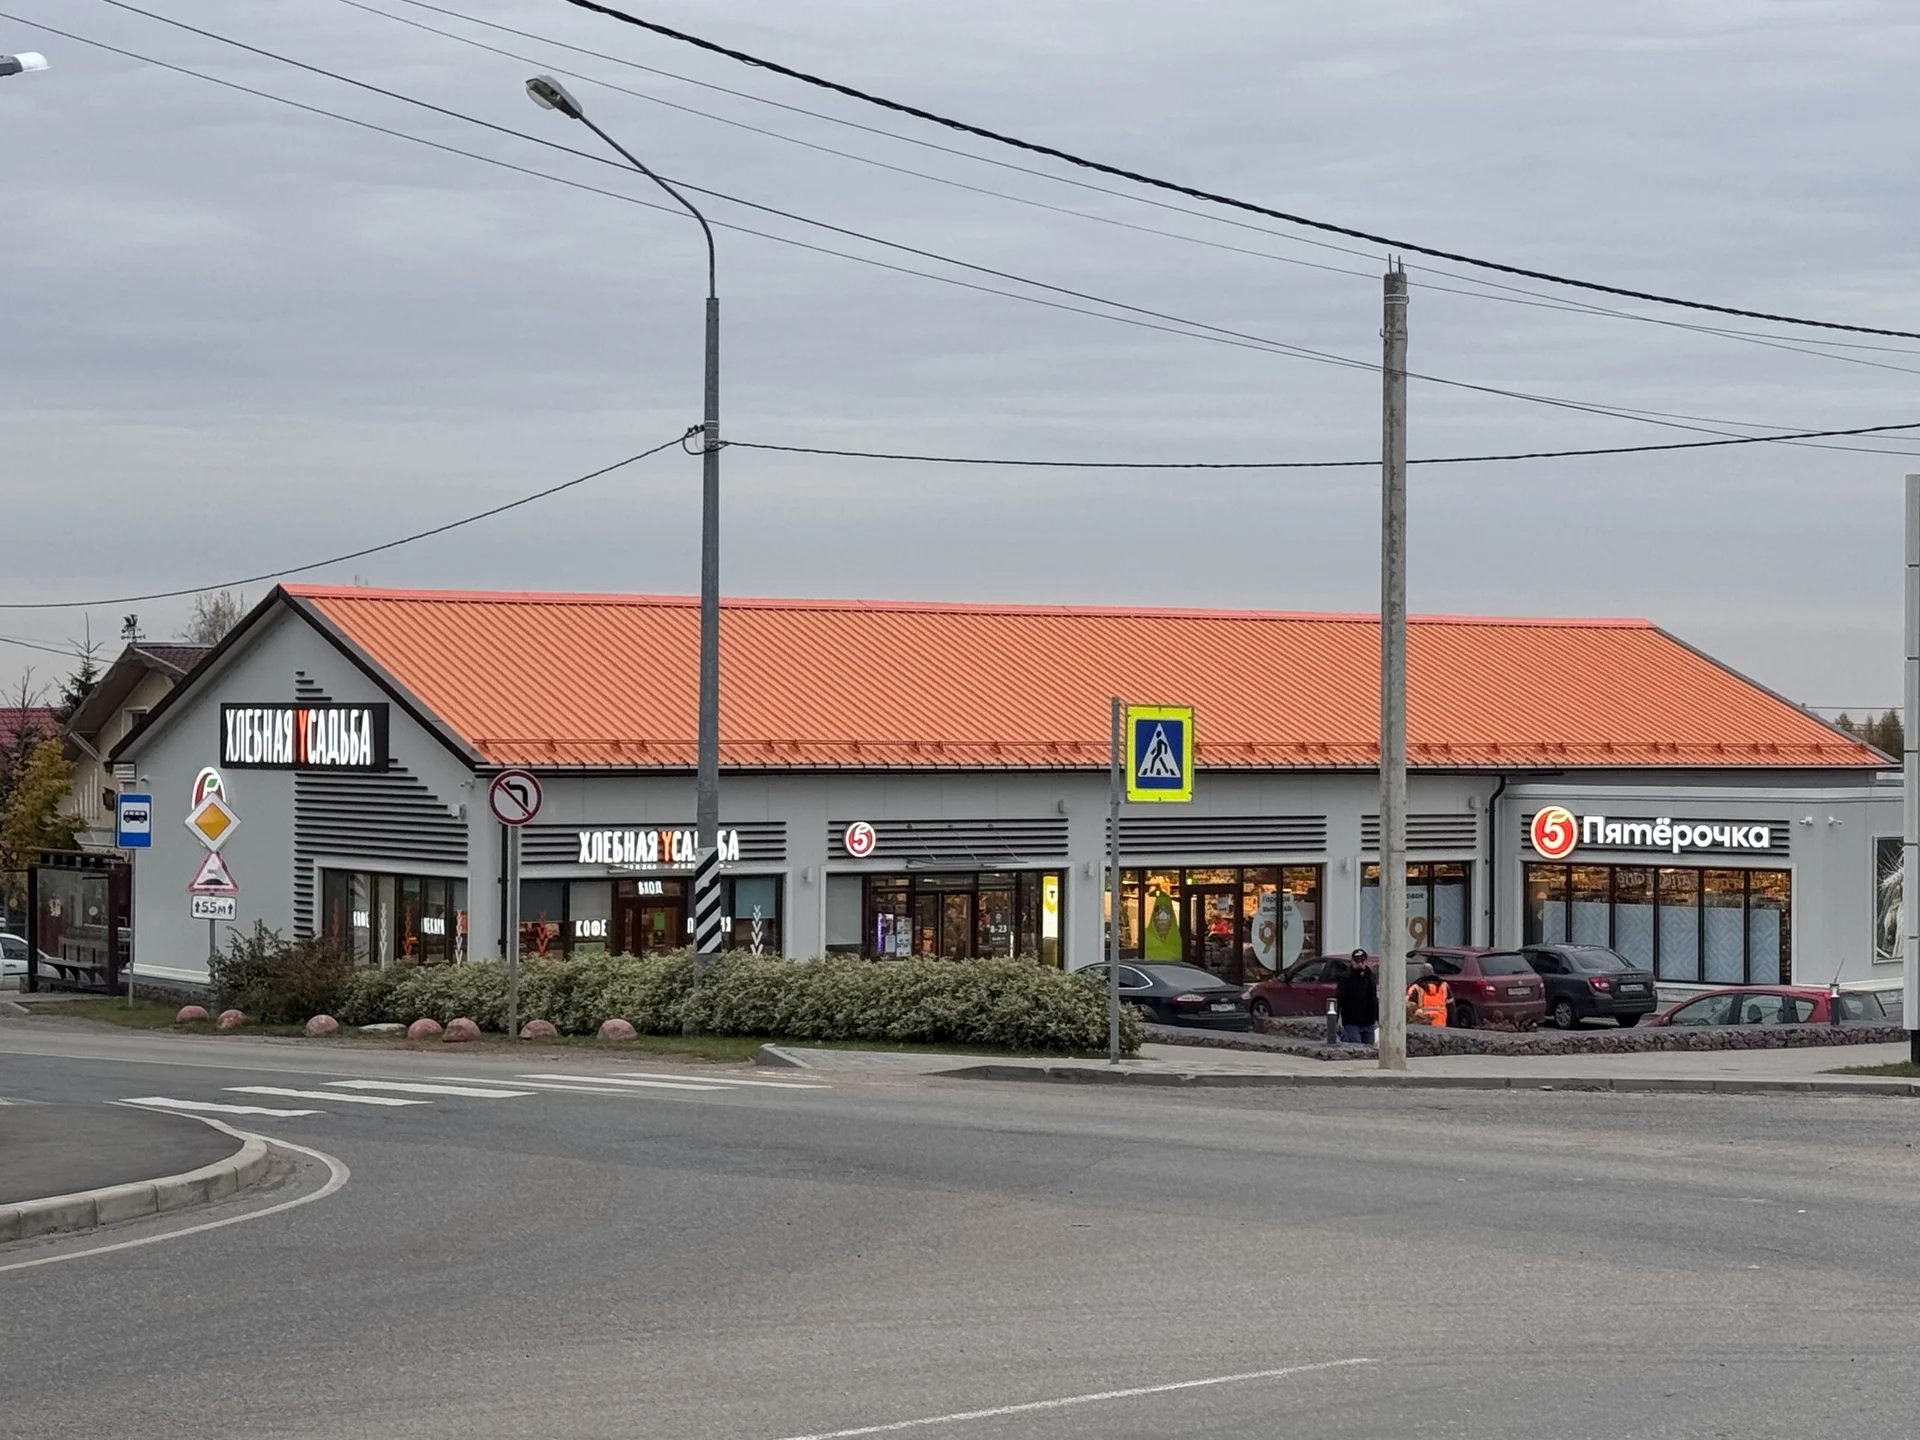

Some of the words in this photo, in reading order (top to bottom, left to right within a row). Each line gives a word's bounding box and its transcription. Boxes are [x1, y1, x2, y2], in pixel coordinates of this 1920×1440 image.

[225, 708, 294, 763] ХЛЕБНАЯ
[578, 831, 659, 863] ХЛЕБНАЯ
[1582, 815, 1770, 854] Пятёрочка
[637, 880, 664, 895] ВХОД
[575, 919, 607, 937] КОФЕ
